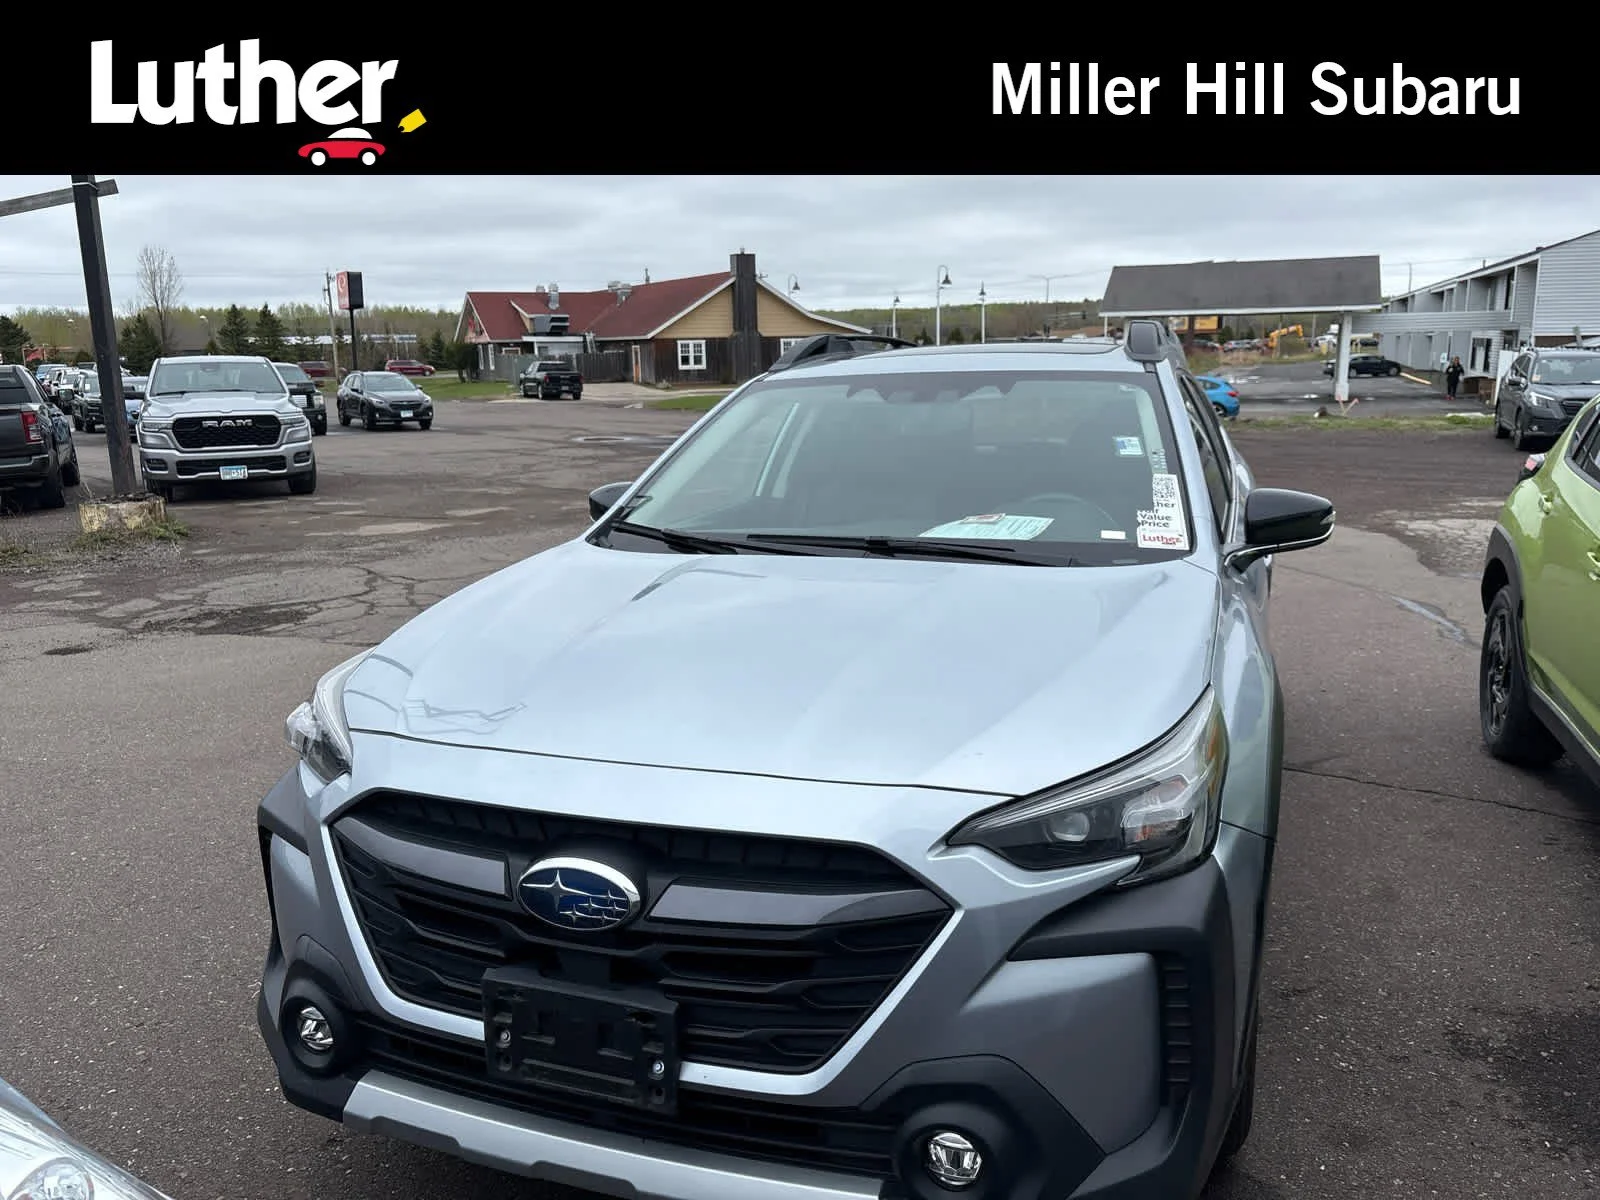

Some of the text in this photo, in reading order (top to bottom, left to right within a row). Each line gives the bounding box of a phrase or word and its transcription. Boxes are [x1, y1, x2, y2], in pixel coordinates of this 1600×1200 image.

[202, 419, 253, 428] RAM
[1139, 513, 1172, 521] Value
[1141, 520, 1170, 528] Price
[1142, 534, 1183, 543] Luther
